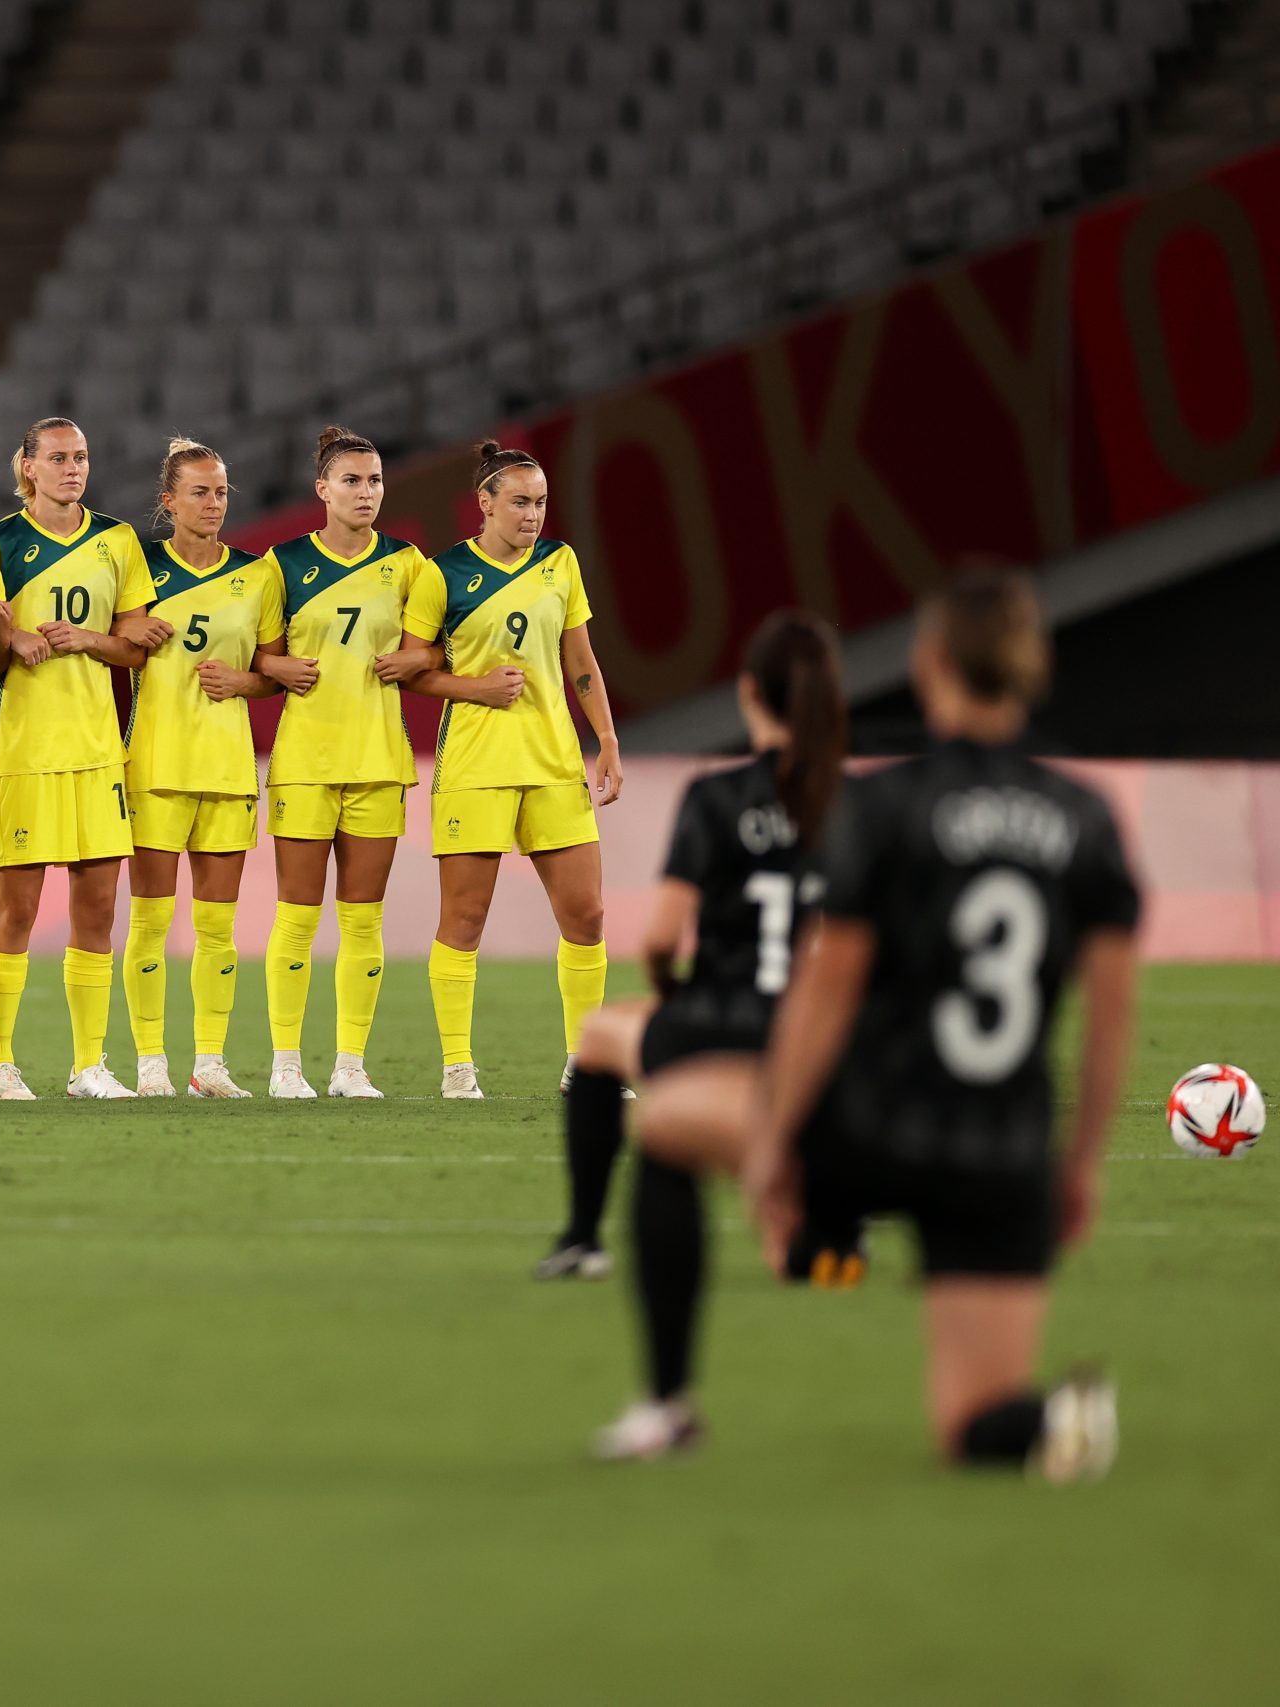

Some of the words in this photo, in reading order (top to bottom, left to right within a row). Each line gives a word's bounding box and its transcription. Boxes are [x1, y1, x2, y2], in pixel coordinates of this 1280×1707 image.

[49, 585, 91, 625] 10
[183, 614, 211, 653] 5
[336, 607, 362, 646] 7
[506, 611, 528, 650] 9
[931, 865, 1049, 1085] 3
